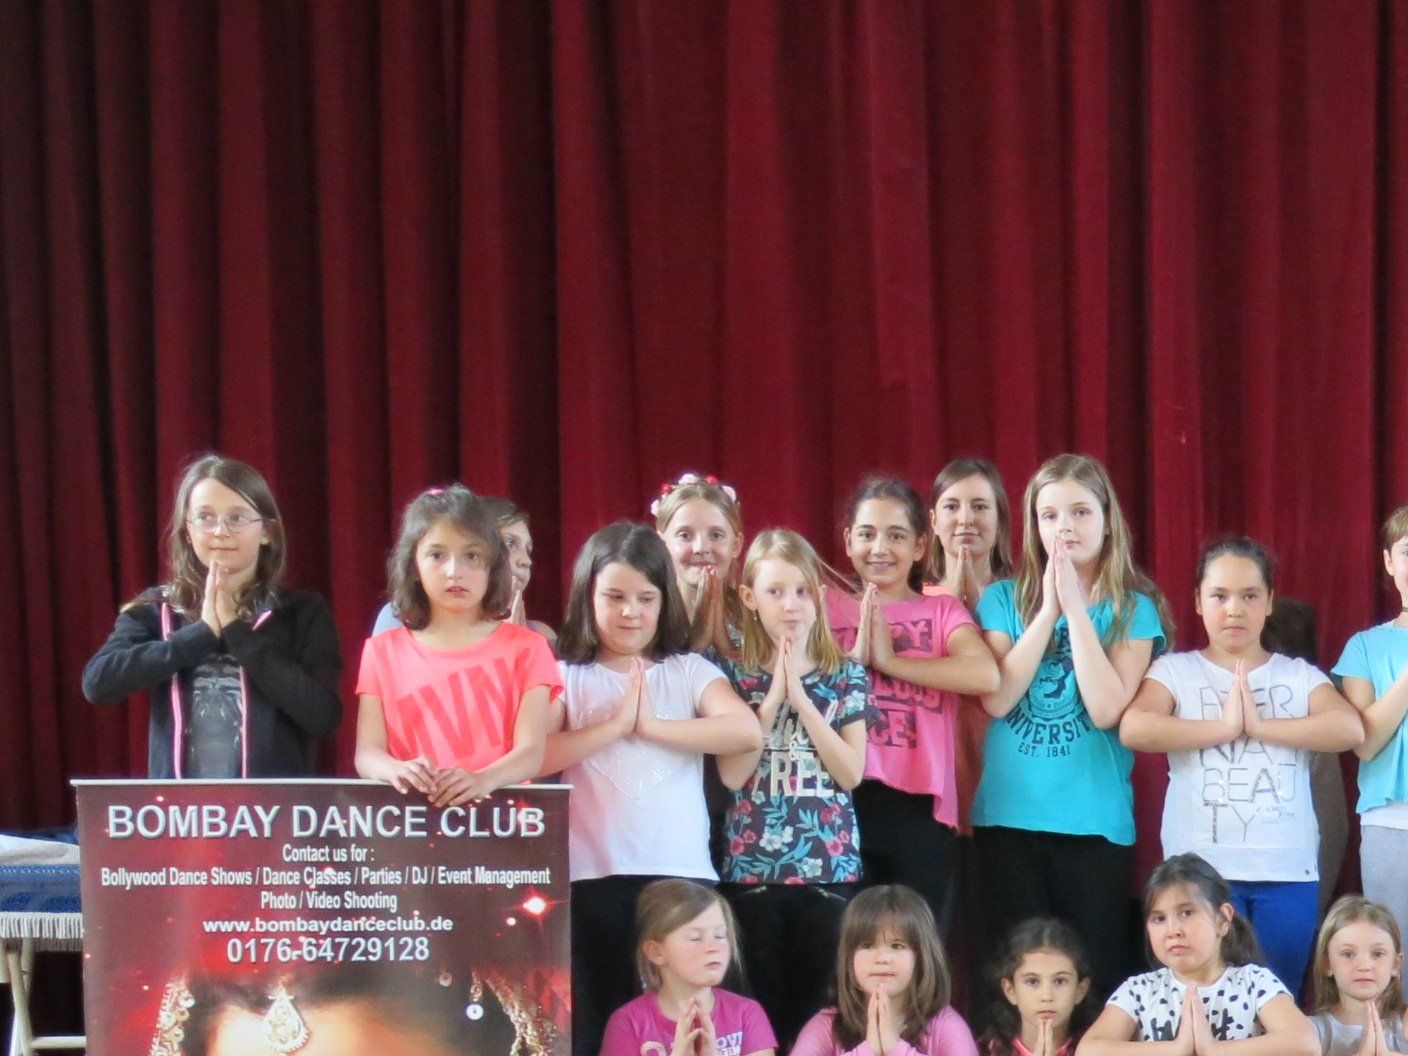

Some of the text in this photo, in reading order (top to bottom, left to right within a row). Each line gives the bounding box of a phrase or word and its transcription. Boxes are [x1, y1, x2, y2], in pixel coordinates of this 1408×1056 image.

[107, 804, 546, 839] BOMBAY DANCE CLUB
[282, 844, 330, 863] Contact
[332, 848, 348, 863] us
[350, 843, 368, 862] for
[101, 867, 167, 891] Bollywood
[169, 867, 208, 886] Dance
[211, 867, 253, 886] Shows
[262, 867, 301, 886] Dance
[303, 866, 352, 887] Classes
[361, 866, 402, 885] Parties
[412, 866, 428, 885] DJ
[437, 866, 473, 885] Event
[474, 866, 551, 889] Management
[260, 891, 297, 910] Photo
[305, 890, 341, 909] Video
[343, 891, 398, 913] Shooting
[203, 916, 454, 936] www.bombaydanceclub.de
[226, 936, 430, 964] 0176-64729128
